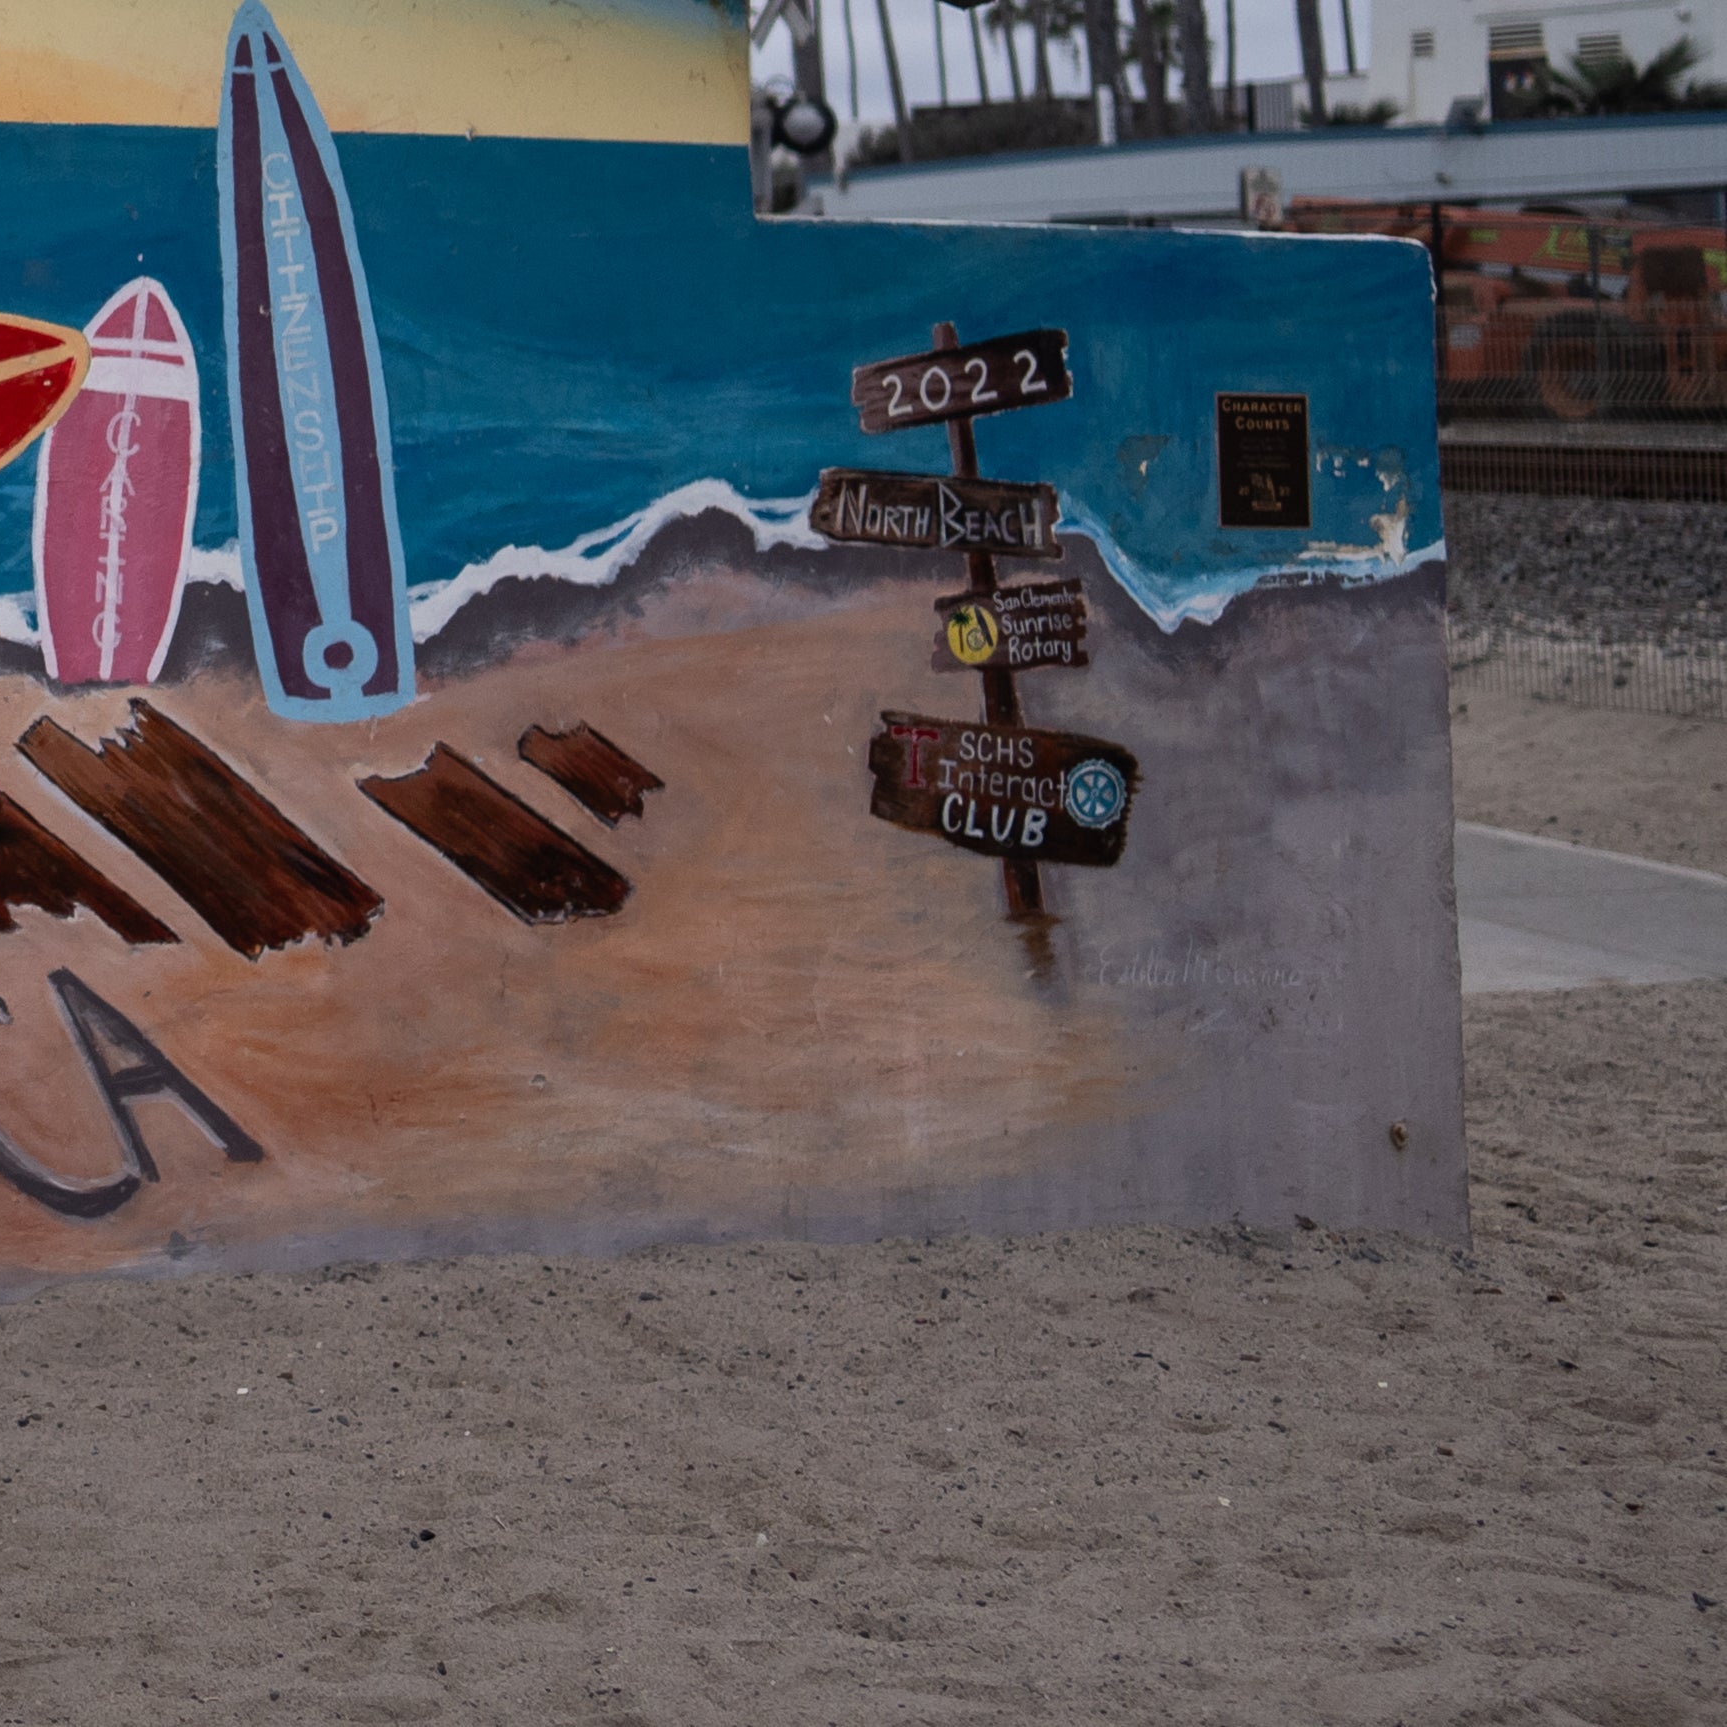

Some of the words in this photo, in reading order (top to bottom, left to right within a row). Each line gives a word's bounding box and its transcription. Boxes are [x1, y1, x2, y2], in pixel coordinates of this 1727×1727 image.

[260, 152, 339, 554] CITIZENSHIP
[881, 348, 1048, 418] 2022
[91, 410, 142, 650] CARING
[833, 481, 932, 538] NORTH
[936, 479, 1044, 551] BEACH
[992, 590, 1021, 613] San
[1001, 612, 1074, 637] Sunrise
[1008, 635, 1072, 665] Rotary
[958, 730, 1034, 769] SCHS
[937, 758, 1067, 809] Interact
[941, 792, 1048, 848] CLUB
